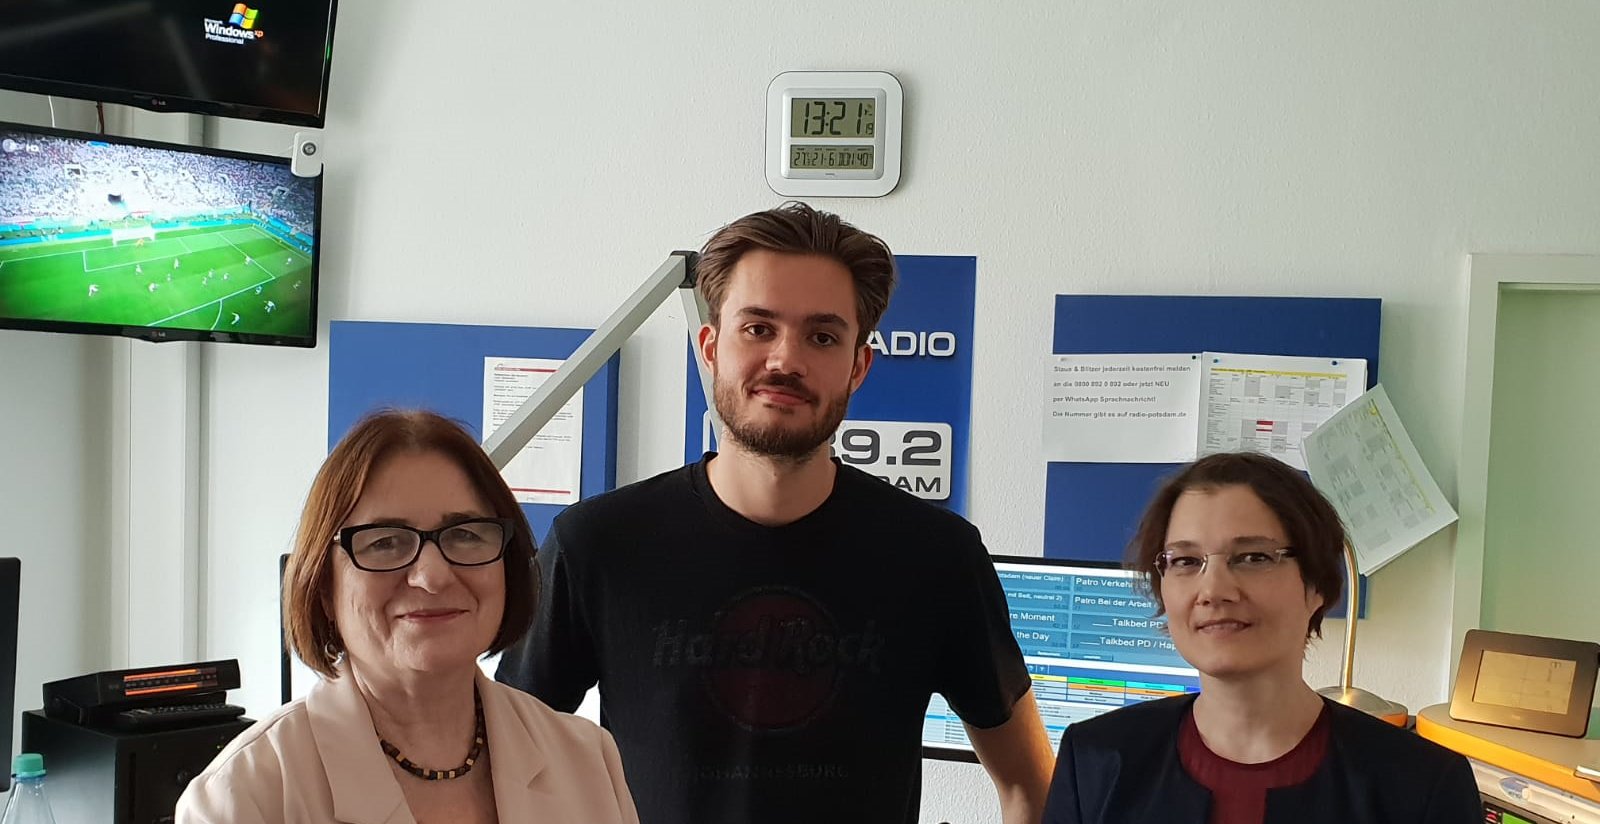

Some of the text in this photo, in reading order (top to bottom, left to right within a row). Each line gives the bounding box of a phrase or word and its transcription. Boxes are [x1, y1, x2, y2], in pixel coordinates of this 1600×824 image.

[204, 23, 254, 39] Windows
[803, 101, 863, 135] 13:21
[1075, 577, 1099, 586] Patro
[1074, 596, 1096, 605] Patro
[1112, 598, 1126, 607] der
[1128, 600, 1152, 609] Arbeit
[1020, 612, 1056, 622] Moment
[1016, 631, 1050, 642] the Day
[1137, 639, 1151, 648] PD
